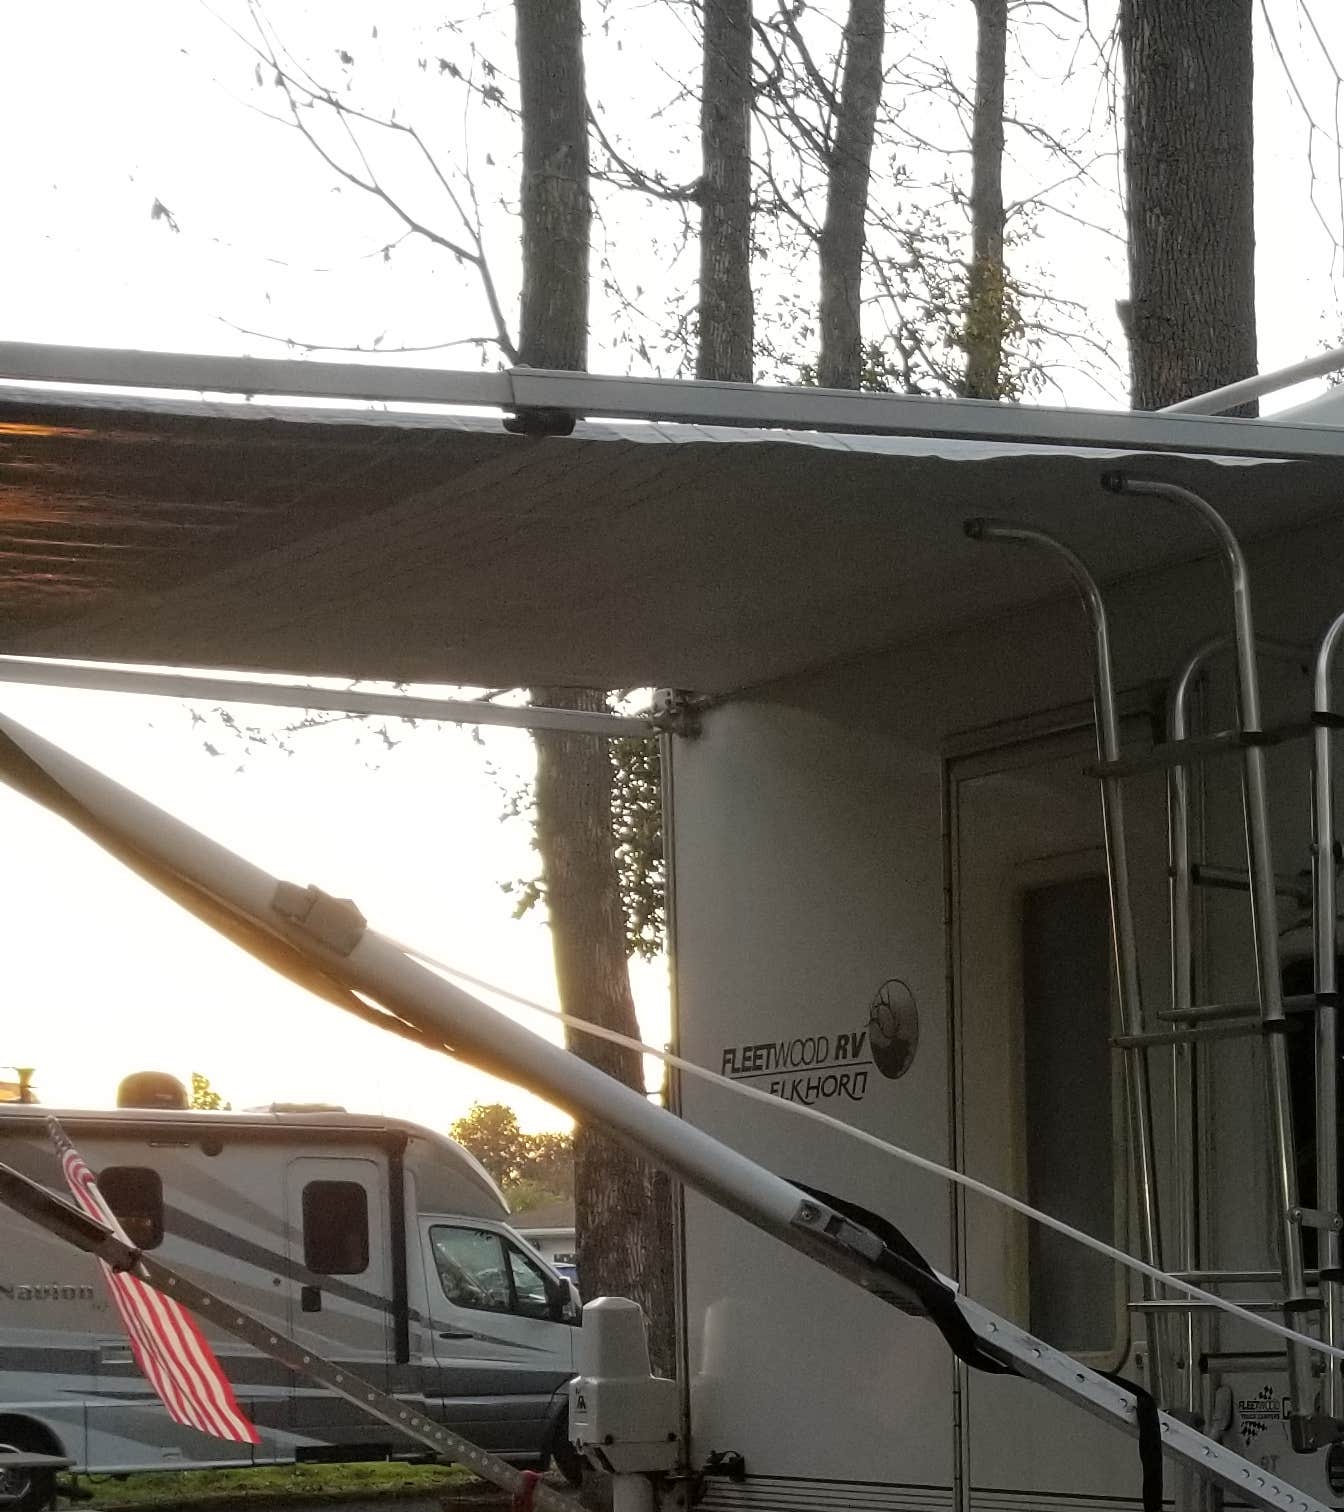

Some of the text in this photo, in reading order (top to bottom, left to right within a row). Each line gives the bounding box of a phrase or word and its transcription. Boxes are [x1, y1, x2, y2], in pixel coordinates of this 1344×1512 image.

[722, 1032, 867, 1076] FLEETWOOD RV
[770, 1071, 868, 1106] ELKHORN
